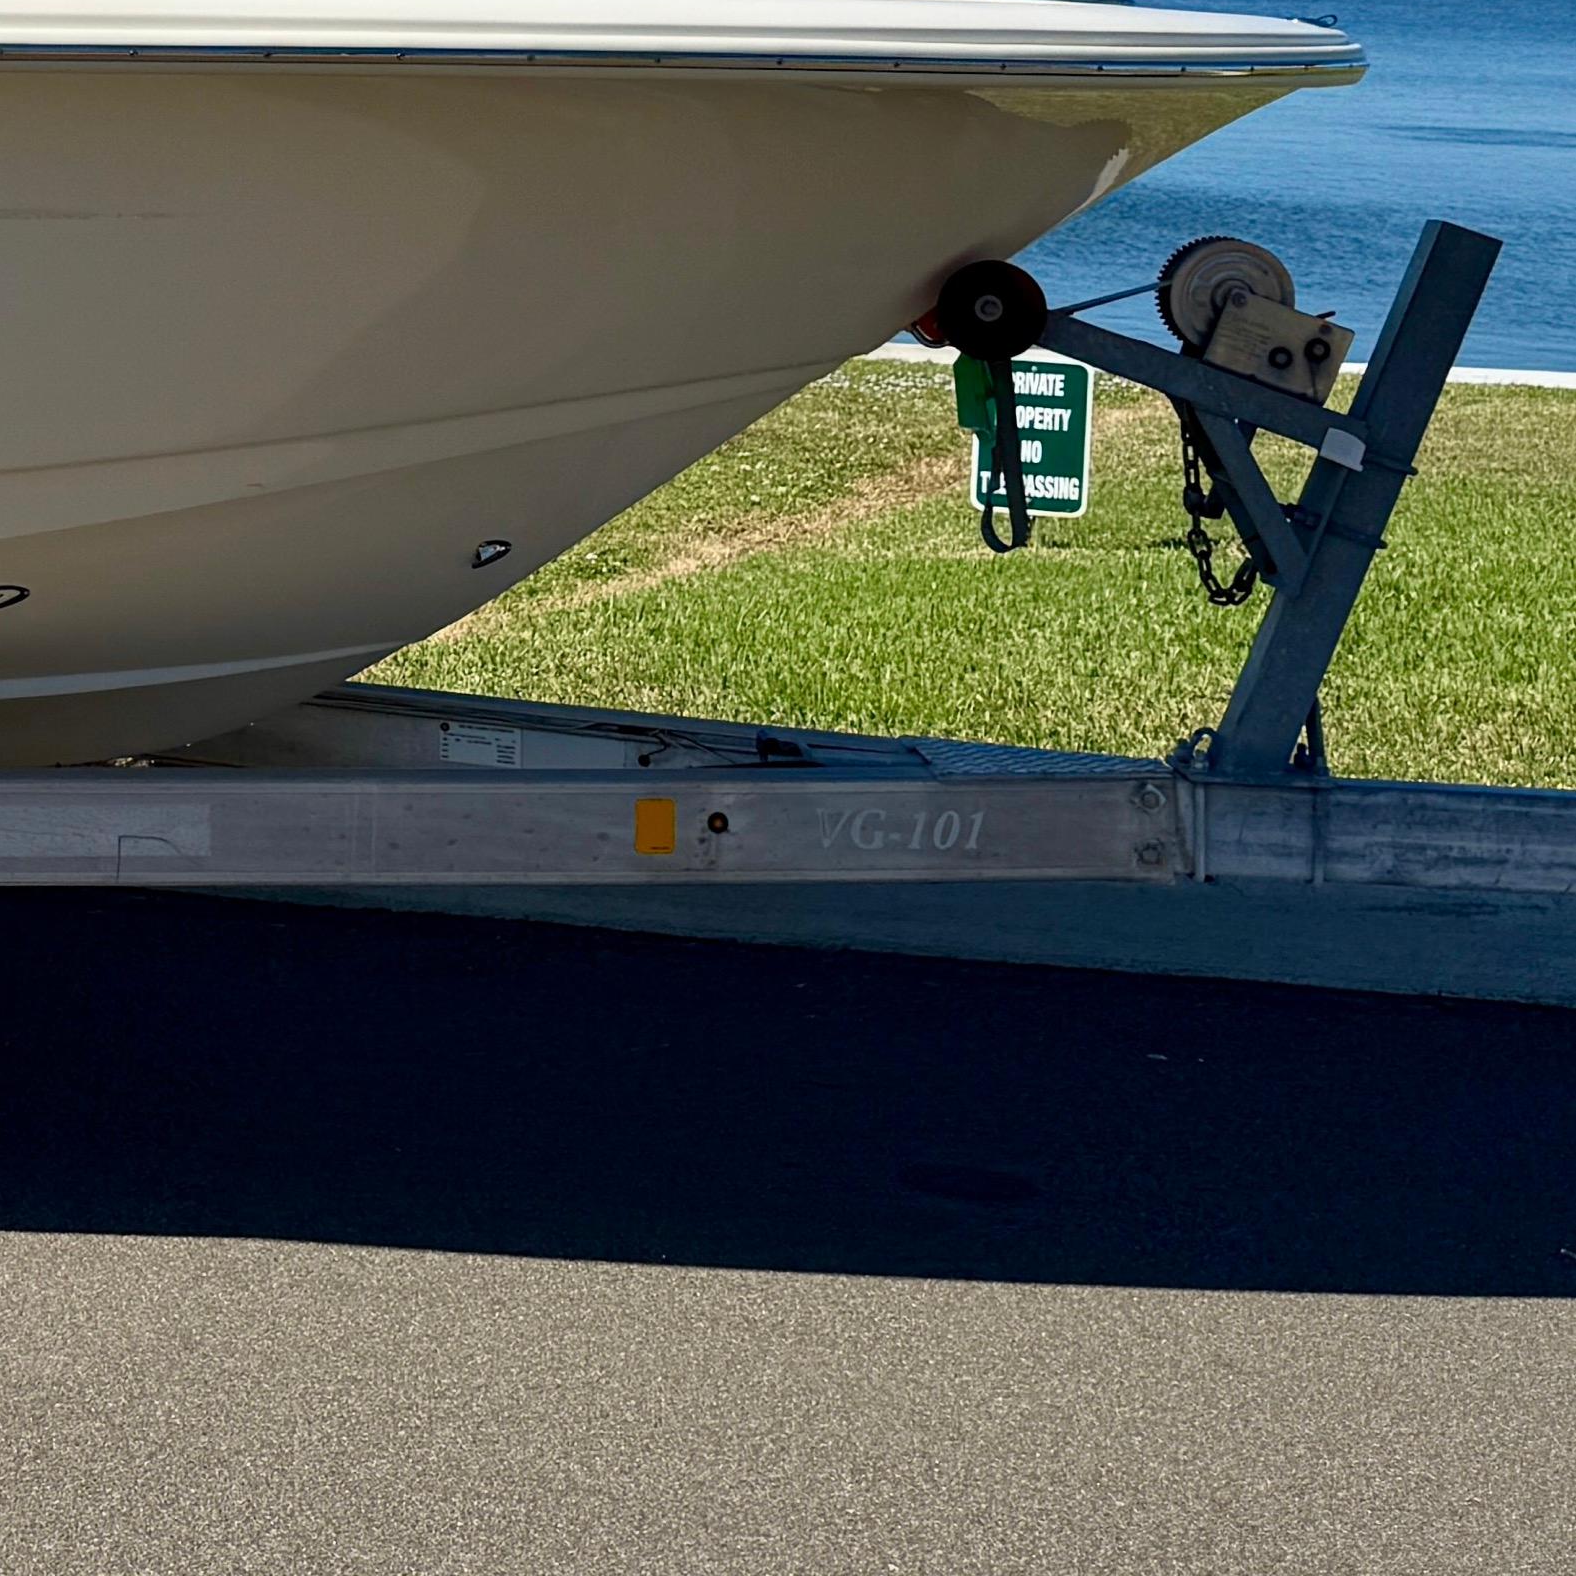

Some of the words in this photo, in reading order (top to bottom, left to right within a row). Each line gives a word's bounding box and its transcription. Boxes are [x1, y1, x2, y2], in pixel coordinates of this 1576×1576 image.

[1012, 372, 1065, 396] RIVATE
[1015, 405, 1072, 431] OPERTY
[1020, 440, 1042, 463] NO
